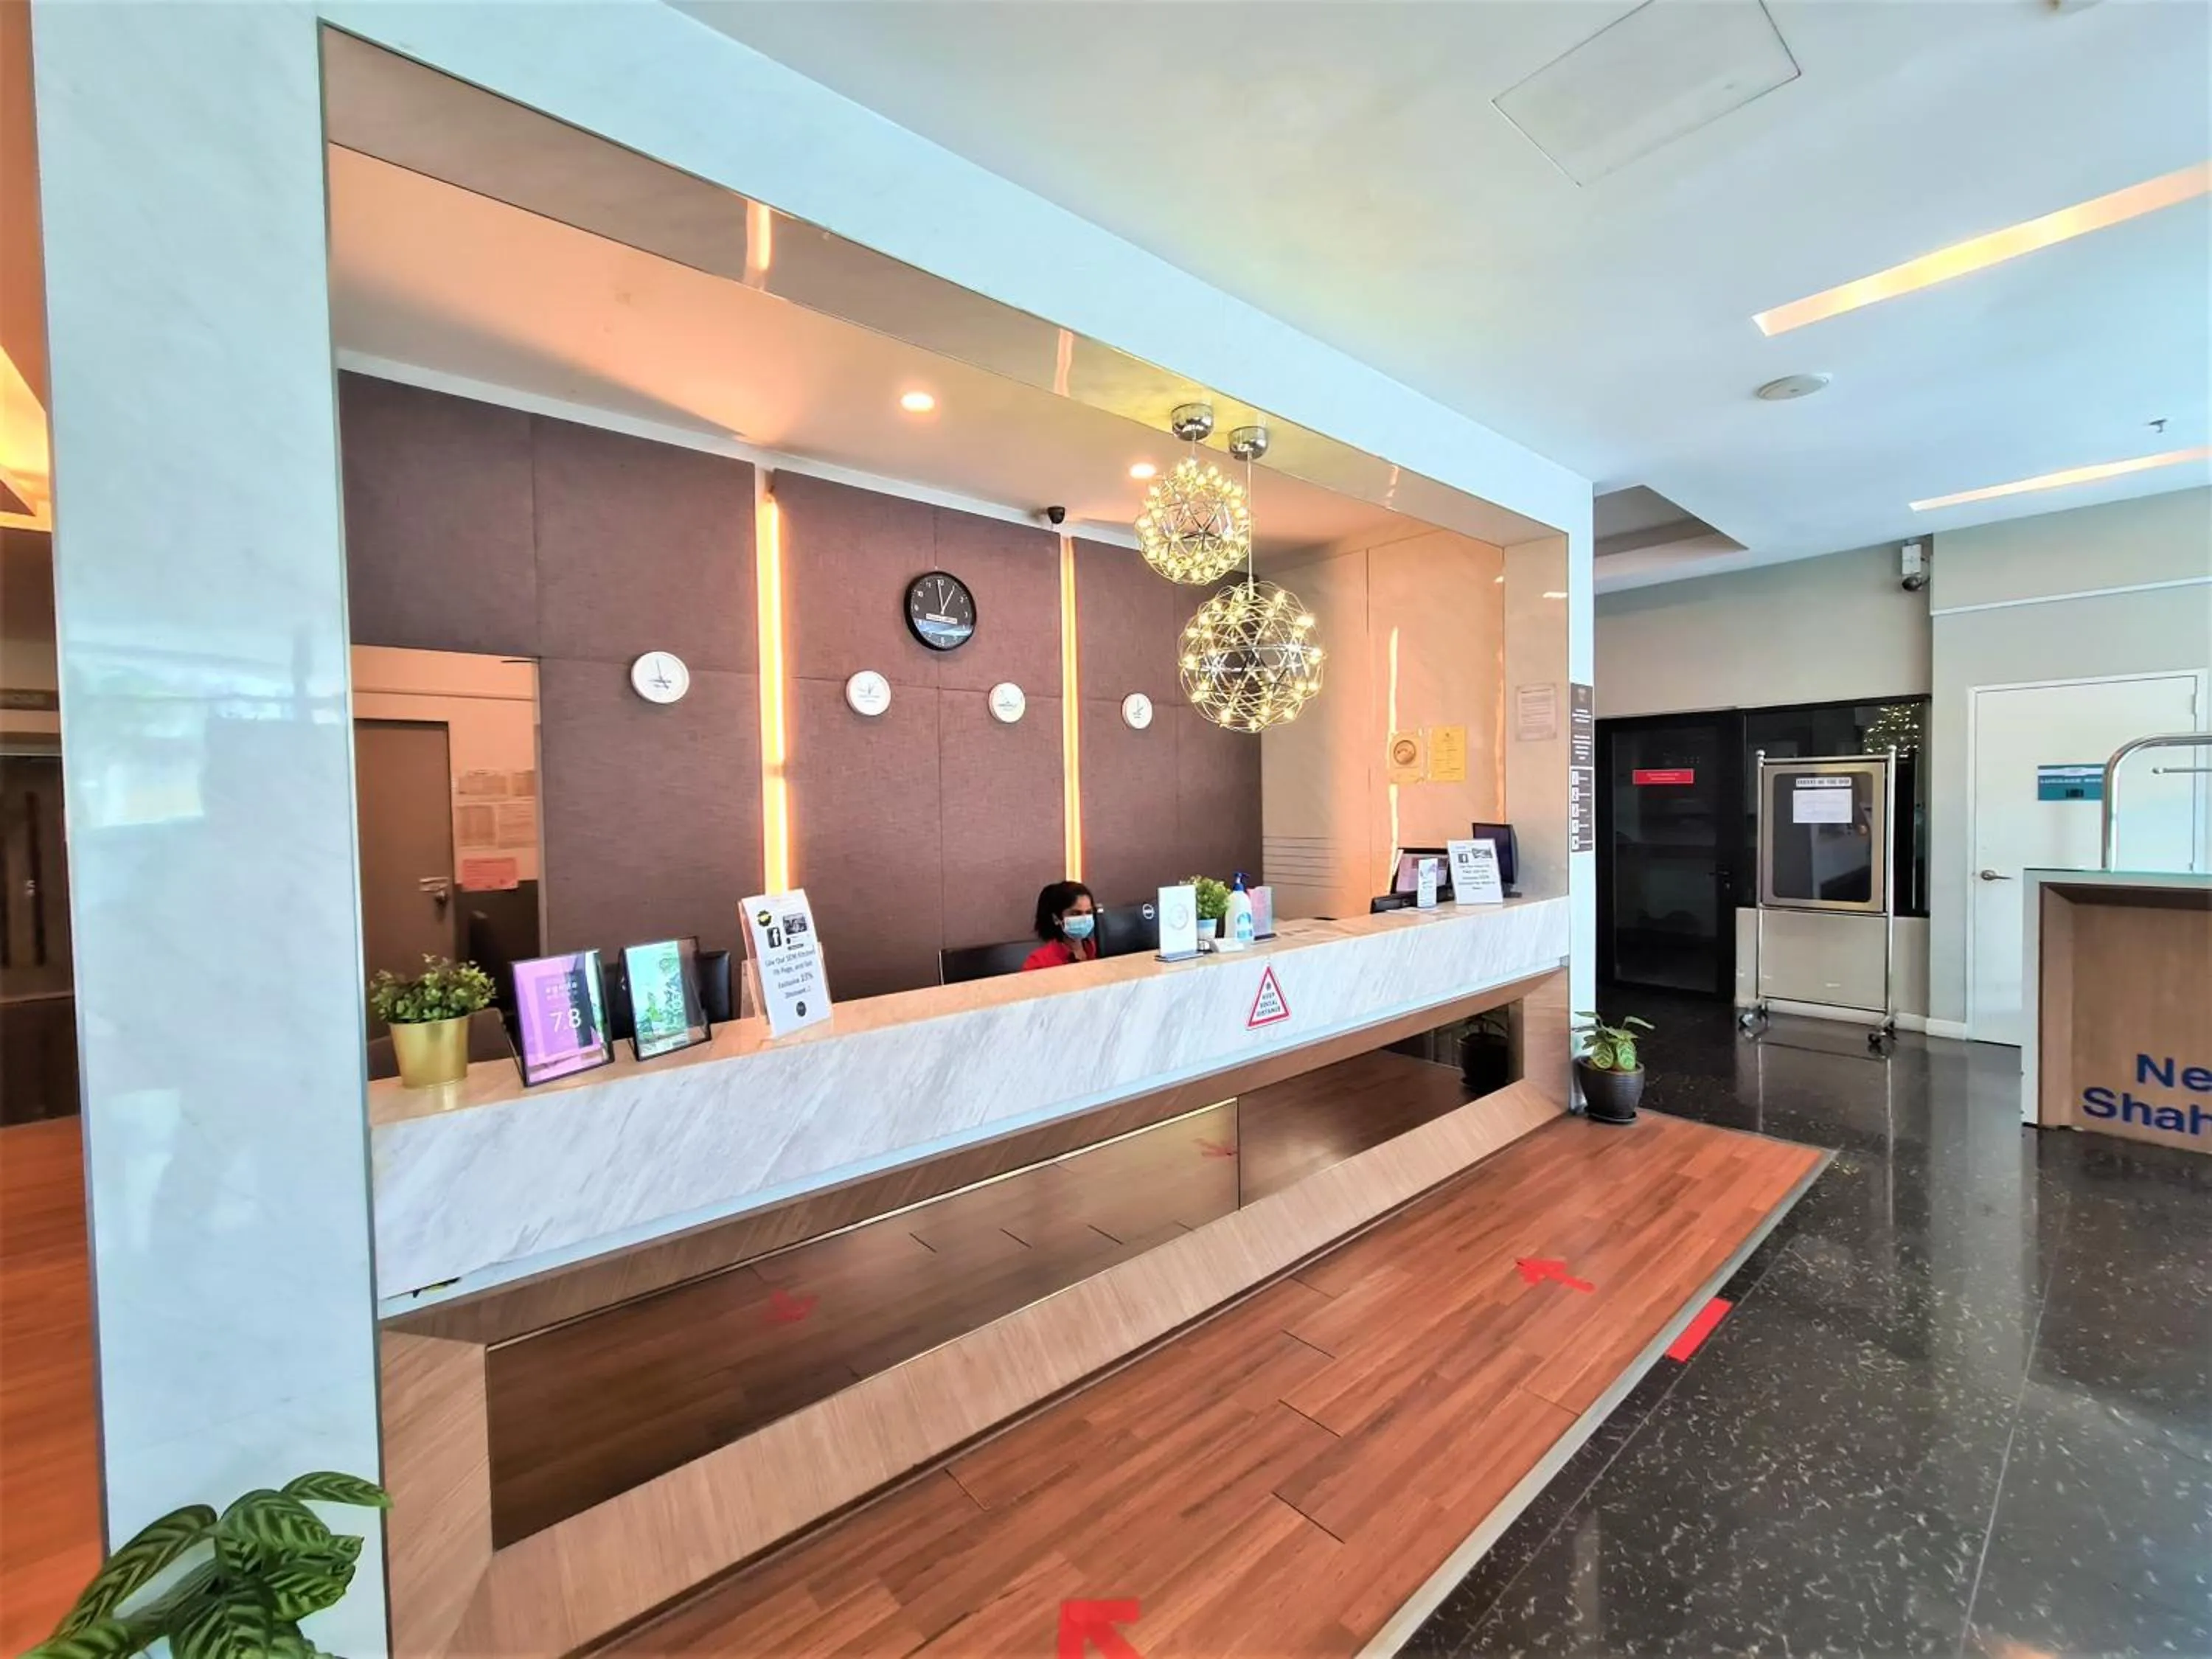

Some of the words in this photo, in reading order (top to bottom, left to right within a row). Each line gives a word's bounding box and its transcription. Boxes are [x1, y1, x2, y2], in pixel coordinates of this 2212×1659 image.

[1262, 992, 1275, 1000] KEEP
[1260, 1000, 1278, 1009] SOCIAL
[1256, 1005, 1281, 1017] DISTANCE
[2136, 1053, 2212, 1092] Ne
[2082, 1086, 2212, 1135] Shah
